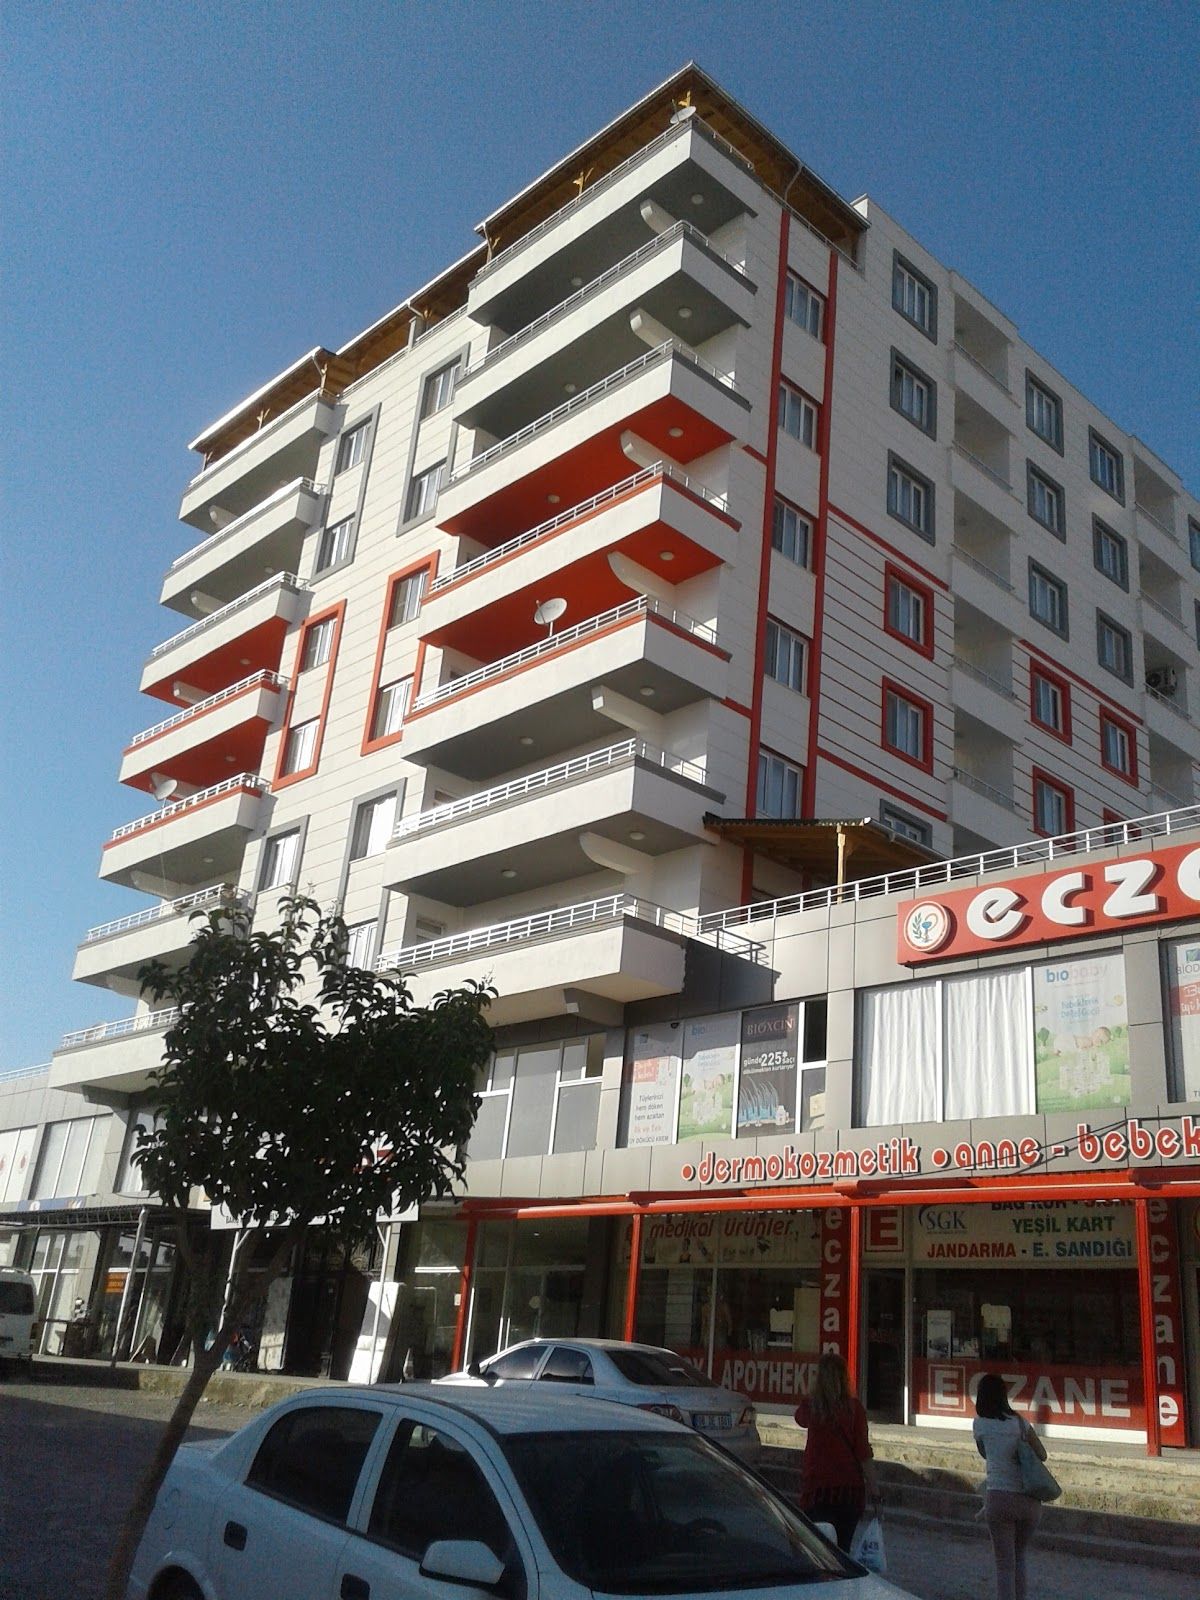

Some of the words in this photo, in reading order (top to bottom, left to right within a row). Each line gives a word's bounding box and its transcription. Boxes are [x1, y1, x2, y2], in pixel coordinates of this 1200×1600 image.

[698, 1138, 919, 1184] dermokozmetik
[953, 1137, 1040, 1170] anne
[1077, 1115, 1200, 1163] bebek
[650, 1217, 715, 1239] medikal
[870, 1210, 899, 1246] E
[925, 1209, 967, 1230] SGK
[1012, 1215, 1061, 1237] YEŞİL
[1067, 1215, 1116, 1233] KART
[927, 1242, 1017, 1259] JANDARMA
[1032, 1242, 1050, 1258] E.
[1056, 1238, 1133, 1258] SANDIĞI
[823, 1207, 843, 1357] eczan
[1149, 1198, 1180, 1428] eczane
